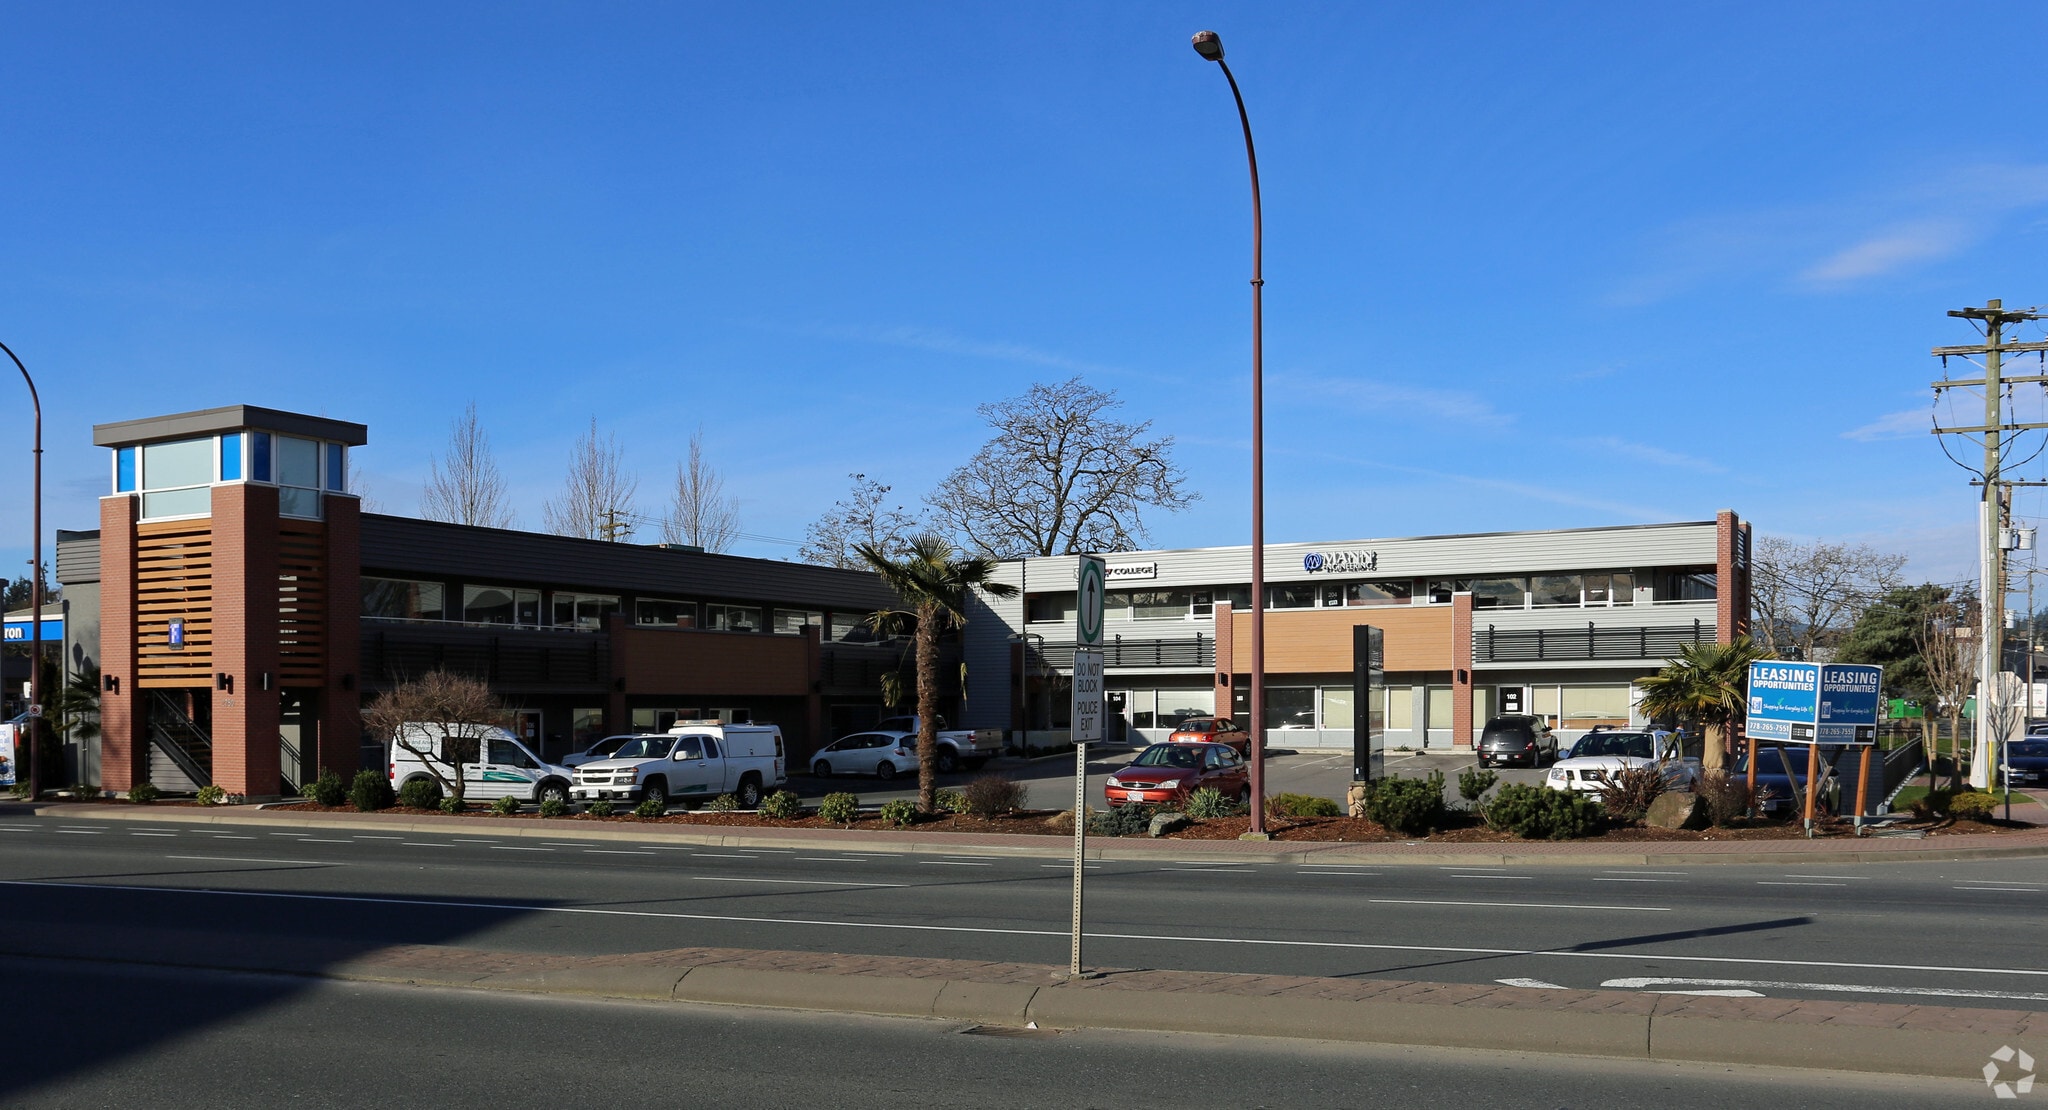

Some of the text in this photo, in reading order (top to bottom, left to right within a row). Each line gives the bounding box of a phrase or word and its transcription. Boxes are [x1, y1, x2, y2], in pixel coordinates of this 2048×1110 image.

[1322, 549, 1373, 564] MANN
[1114, 566, 1154, 575] COLLEGE
[1323, 561, 1375, 572] ENGINEERING
[1077, 663, 1100, 676] DO NOT
[1753, 667, 1815, 683] LEASING
[1824, 671, 1878, 685] LEASING
[1077, 679, 1098, 693] BLOCK
[1753, 679, 1815, 692] OPPORTUNITIES
[1823, 683, 1877, 693] OPPORTUNITIES
[1077, 701, 1098, 715] POLICE
[1080, 718, 1094, 731] EXIT
